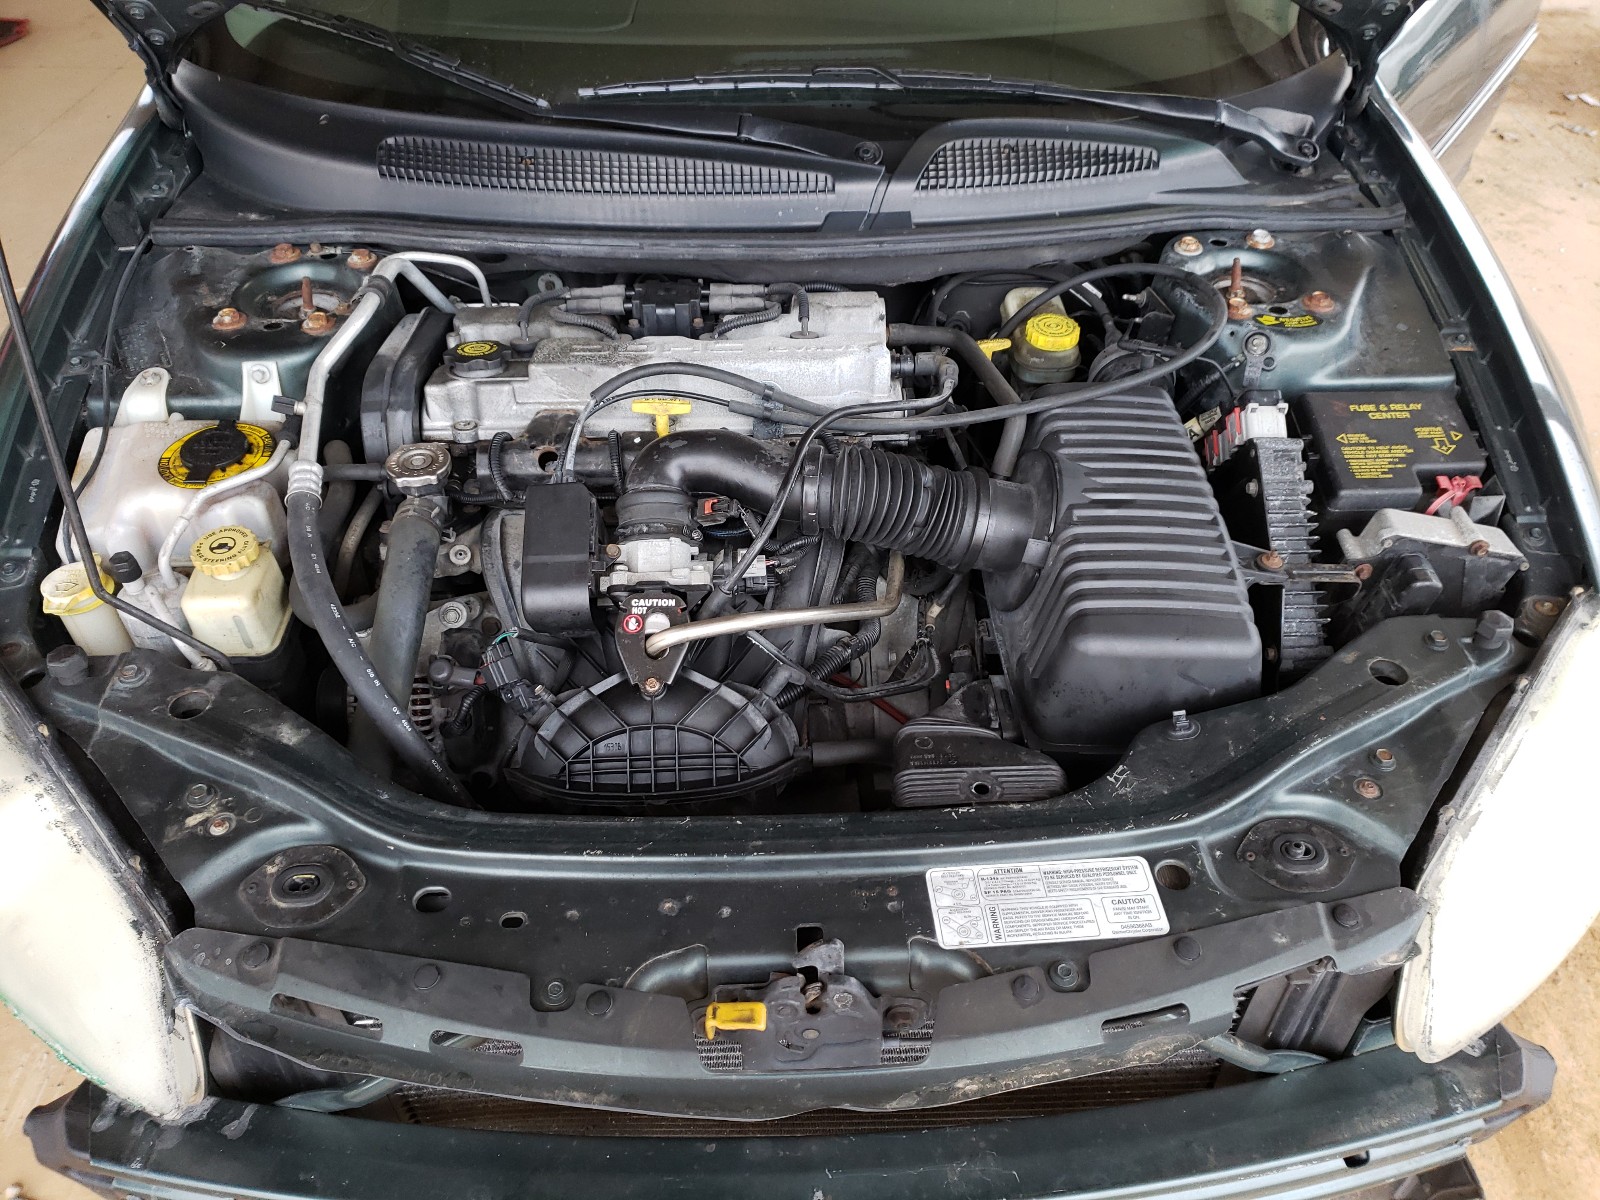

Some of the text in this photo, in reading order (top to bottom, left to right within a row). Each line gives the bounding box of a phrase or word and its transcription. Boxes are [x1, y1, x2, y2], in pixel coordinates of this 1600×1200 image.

[1349, 404, 1377, 412] FUSE
[1391, 403, 1422, 411] RELAY
[1368, 412, 1411, 420] CENTER
[203, 532, 217, 540] USE
[632, 598, 676, 606] CAUTION
[989, 906, 1001, 941] WARNING
